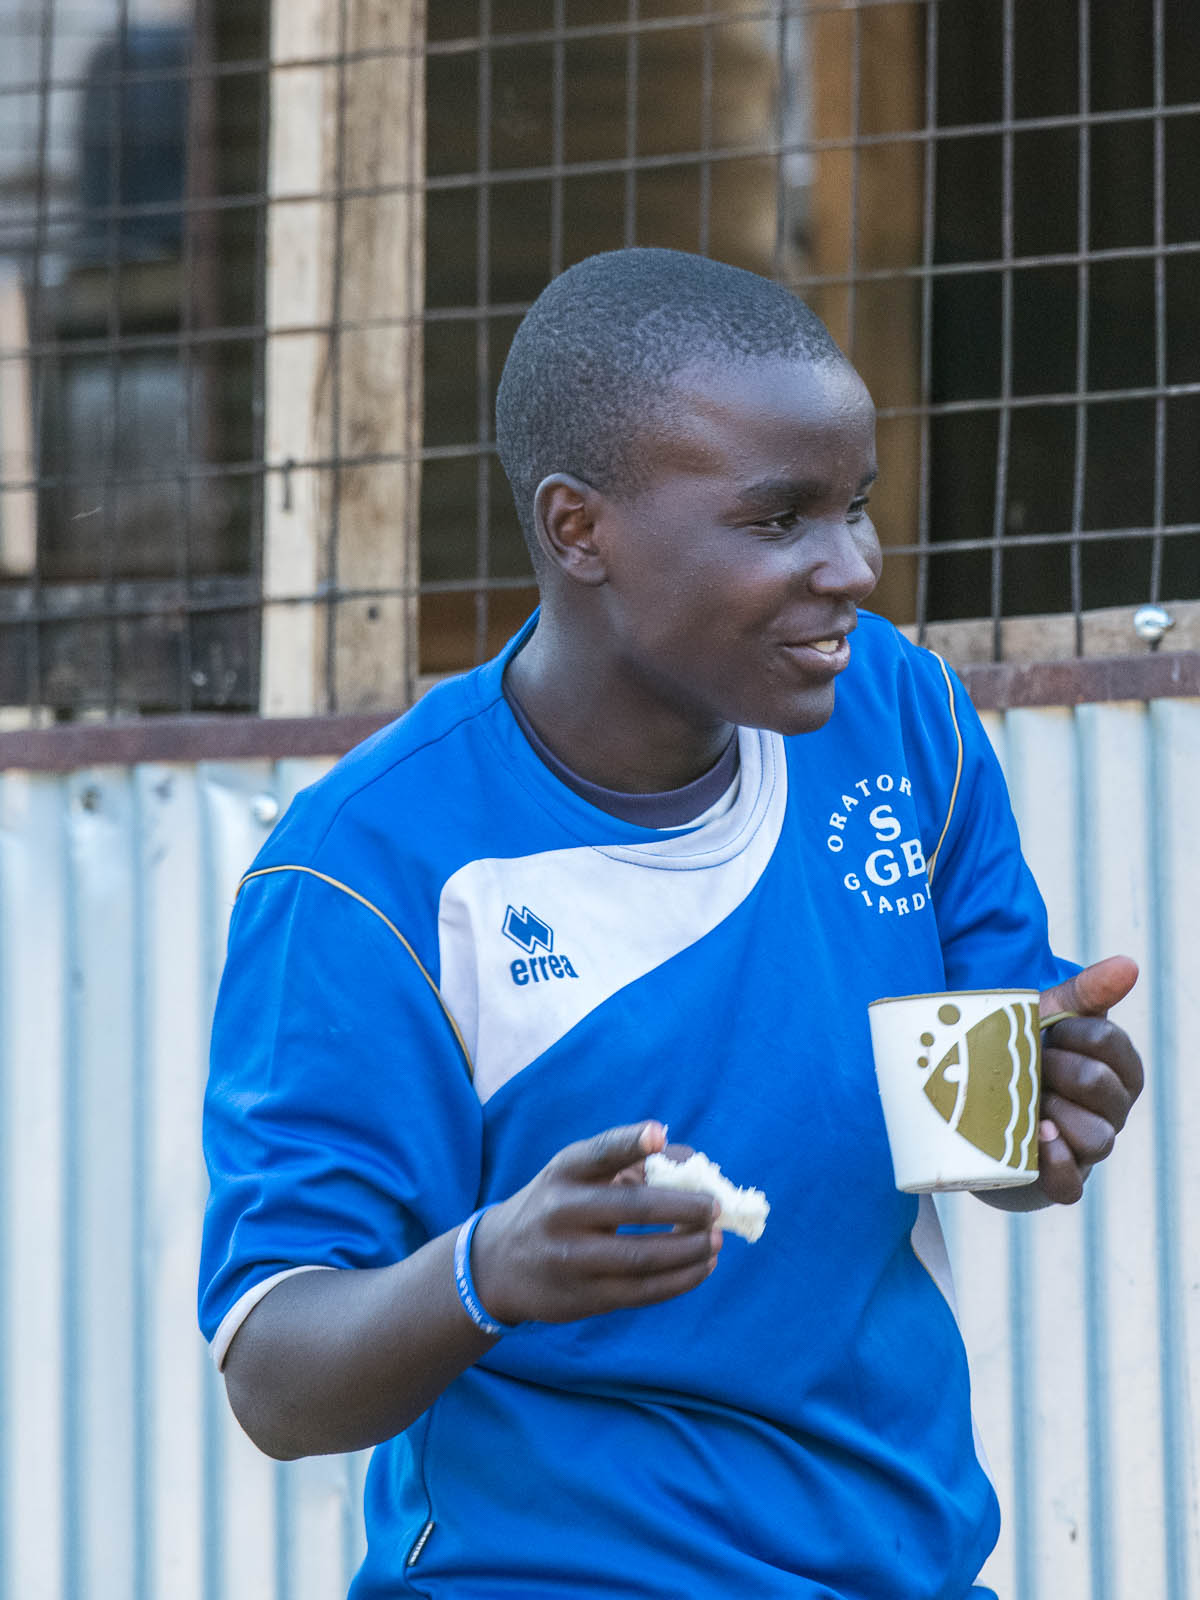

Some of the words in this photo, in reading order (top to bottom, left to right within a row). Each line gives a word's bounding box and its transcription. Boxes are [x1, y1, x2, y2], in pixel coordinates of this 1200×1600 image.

[827, 774, 912, 852] ORATOR
[869, 804, 902, 842] S
[864, 838, 927, 887] GB
[510, 954, 580, 986] errea
